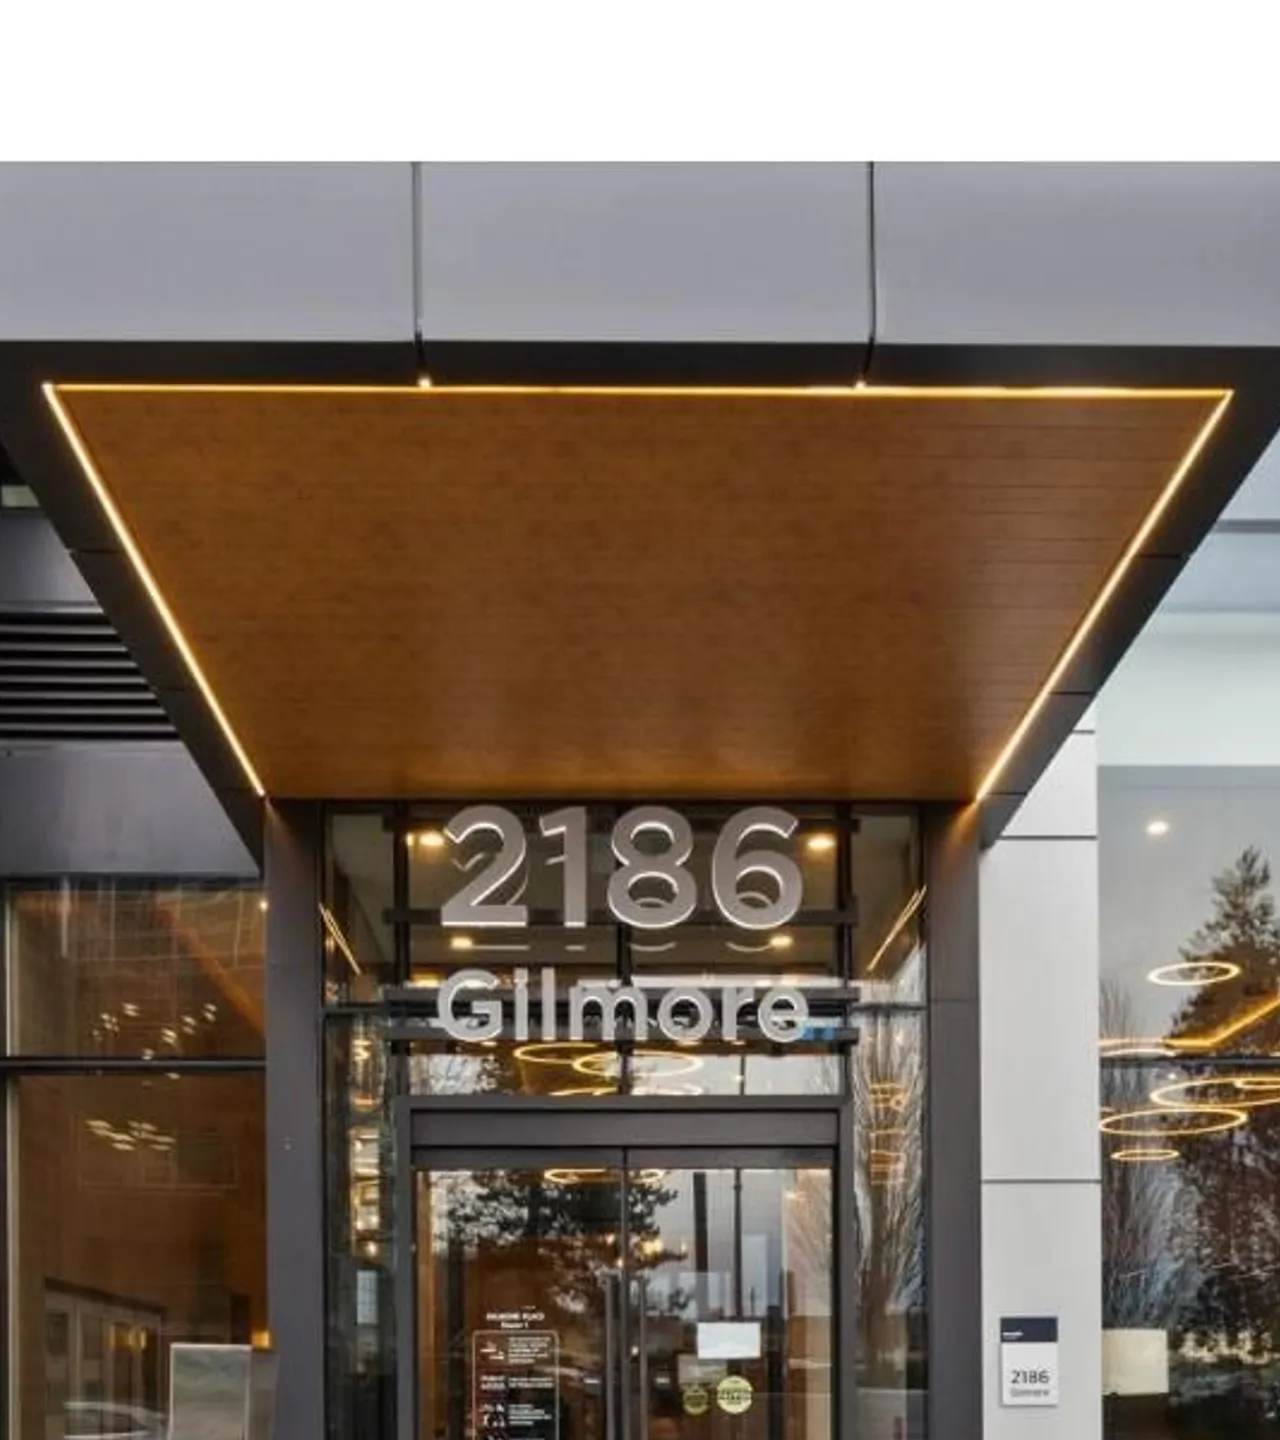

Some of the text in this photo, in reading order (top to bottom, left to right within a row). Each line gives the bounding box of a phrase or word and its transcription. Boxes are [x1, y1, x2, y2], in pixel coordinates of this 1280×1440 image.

[440, 805, 803, 930] 2186
[436, 967, 810, 1043] Gilmore
[1010, 1369, 1050, 1384] 2186
